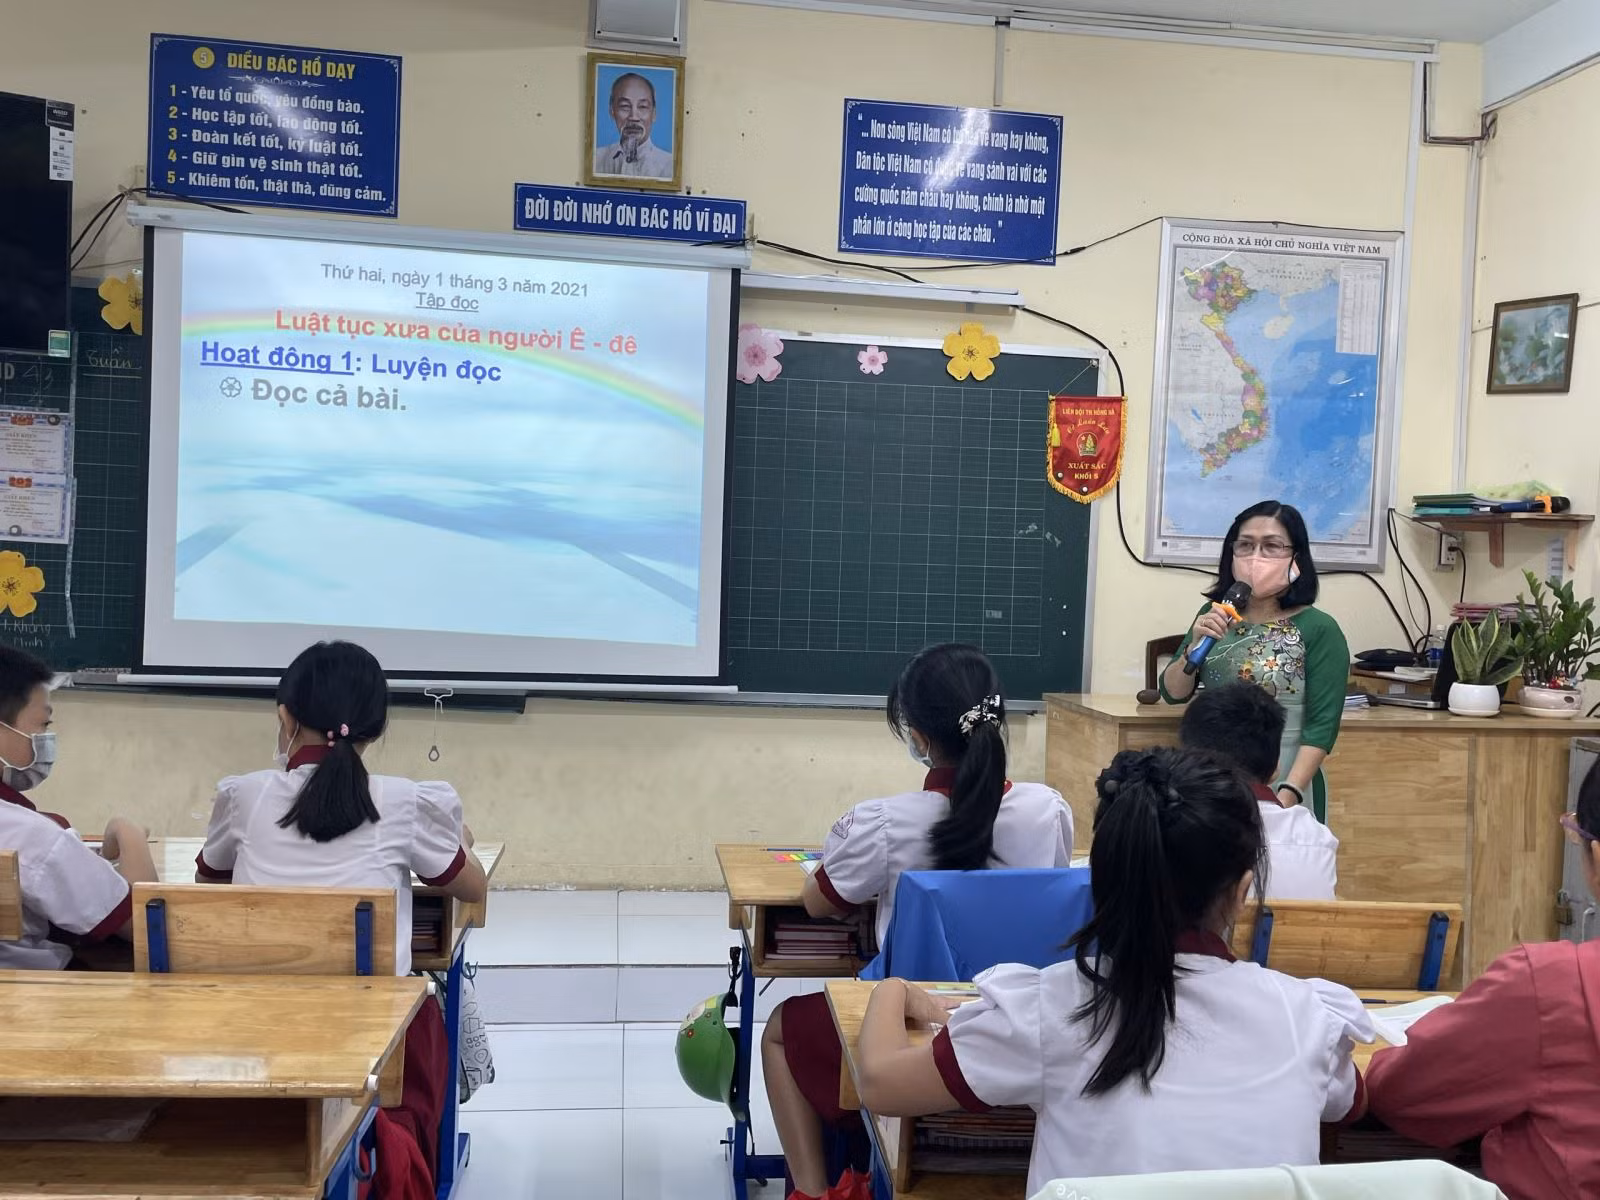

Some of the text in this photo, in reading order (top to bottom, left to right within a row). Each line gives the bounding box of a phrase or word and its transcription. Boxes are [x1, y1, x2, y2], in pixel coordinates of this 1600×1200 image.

[267, 54, 298, 74] BÁC
[302, 56, 322, 76] HỒ
[326, 62, 356, 82] DẠY
[169, 84, 176, 97] 1
[191, 86, 215, 100] Yêu
[219, 86, 232, 102] tổ
[302, 94, 334, 112] đồng
[168, 105, 178, 119] 2
[192, 107, 219, 124] Học
[223, 110, 246, 126] tập
[250, 111, 272, 128] tốt,
[277, 114, 299, 129] lao
[303, 117, 337, 134] động
[341, 119, 363, 135] tốt.
[168, 127, 177, 140] 3
[192, 129, 229, 145] Đoàn
[233, 132, 256, 147] kết
[260, 134, 283, 151] tốt,
[309, 138, 336, 157] luật
[340, 141, 363, 157] tốt.
[870, 119, 886, 139] Non
[887, 120, 906, 142] sông
[907, 121, 921, 145] Việt
[923, 122, 940, 143] Nam
[941, 124, 951, 144] có
[991, 131, 1009, 151] vang
[1010, 130, 1023, 152] hay
[1024, 131, 1049, 155] không,
[168, 149, 177, 162] 4
[192, 151, 218, 166] Giữ
[222, 153, 245, 168] gìn
[250, 156, 267, 172] vệ
[271, 158, 303, 173] sinh
[307, 160, 335, 178] thật
[339, 163, 363, 178] tốt.
[855, 151, 871, 170] Dân
[873, 152, 886, 175] tộc
[887, 153, 902, 176] Việt
[903, 154, 921, 174] Nam
[923, 155, 933, 175] có
[966, 162, 985, 181] vang
[986, 161, 1005, 181] sánh
[1006, 163, 1018, 182] vai
[1020, 162, 1032, 183] với
[1033, 164, 1047, 184] các
[167, 171, 176, 184] 5
[188, 172, 231, 188] Khiêm
[234, 175, 259, 192] tốn,
[263, 179, 288, 195] thật
[291, 181, 316, 197] thà,
[320, 183, 351, 199] dũng
[354, 186, 387, 201] cảm.
[854, 183, 879, 206] cường
[880, 182, 899, 206] quốc
[900, 186, 917, 206] năm
[939, 189, 954, 210] hay
[955, 190, 981, 212] không,
[983, 192, 1004, 212] chính
[1005, 193, 1013, 213] là
[1014, 195, 1029, 214] nhờ
[1030, 196, 1045, 219] một
[525, 193, 736, 238] ĐỜI ĐỜI NHỚ ƠN BÁC HỒ VĨ ĐẠI
[873, 216, 885, 236] lớn
[886, 215, 892, 236] ở
[893, 217, 912, 239] công
[913, 219, 927, 243] học
[929, 220, 941, 243] tập
[942, 219, 956, 240] của
[958, 222, 972, 241] các
[1182, 233, 1211, 244] CỘNG
[1254, 236, 1272, 248] HỘI
[1275, 237, 1295, 248] CHỦ
[1298, 241, 1330, 251] NGHĨA
[1333, 242, 1356, 254] VIỆT
[1358, 246, 1381, 255] NAM
[320, 263, 588, 297] Thứ hai, ngày 1 tháng 3 năm 2021
[415, 291, 479, 312] Tập đọc
[276, 310, 331, 336] Luật
[336, 315, 375, 339] tục
[383, 321, 430, 339] xưa
[437, 322, 481, 343] của
[488, 328, 562, 351] người
[570, 327, 586, 350] Ê
[609, 335, 637, 355] đê
[372, 353, 447, 381] Luyện
[456, 359, 502, 385] đọc
[250, 378, 407, 411] Đọc cả bài.
[1062, 407, 1075, 415] LIÊN
[1068, 461, 1107, 470] XUẤT SẮC
[1074, 471, 1092, 480] KHỐI
